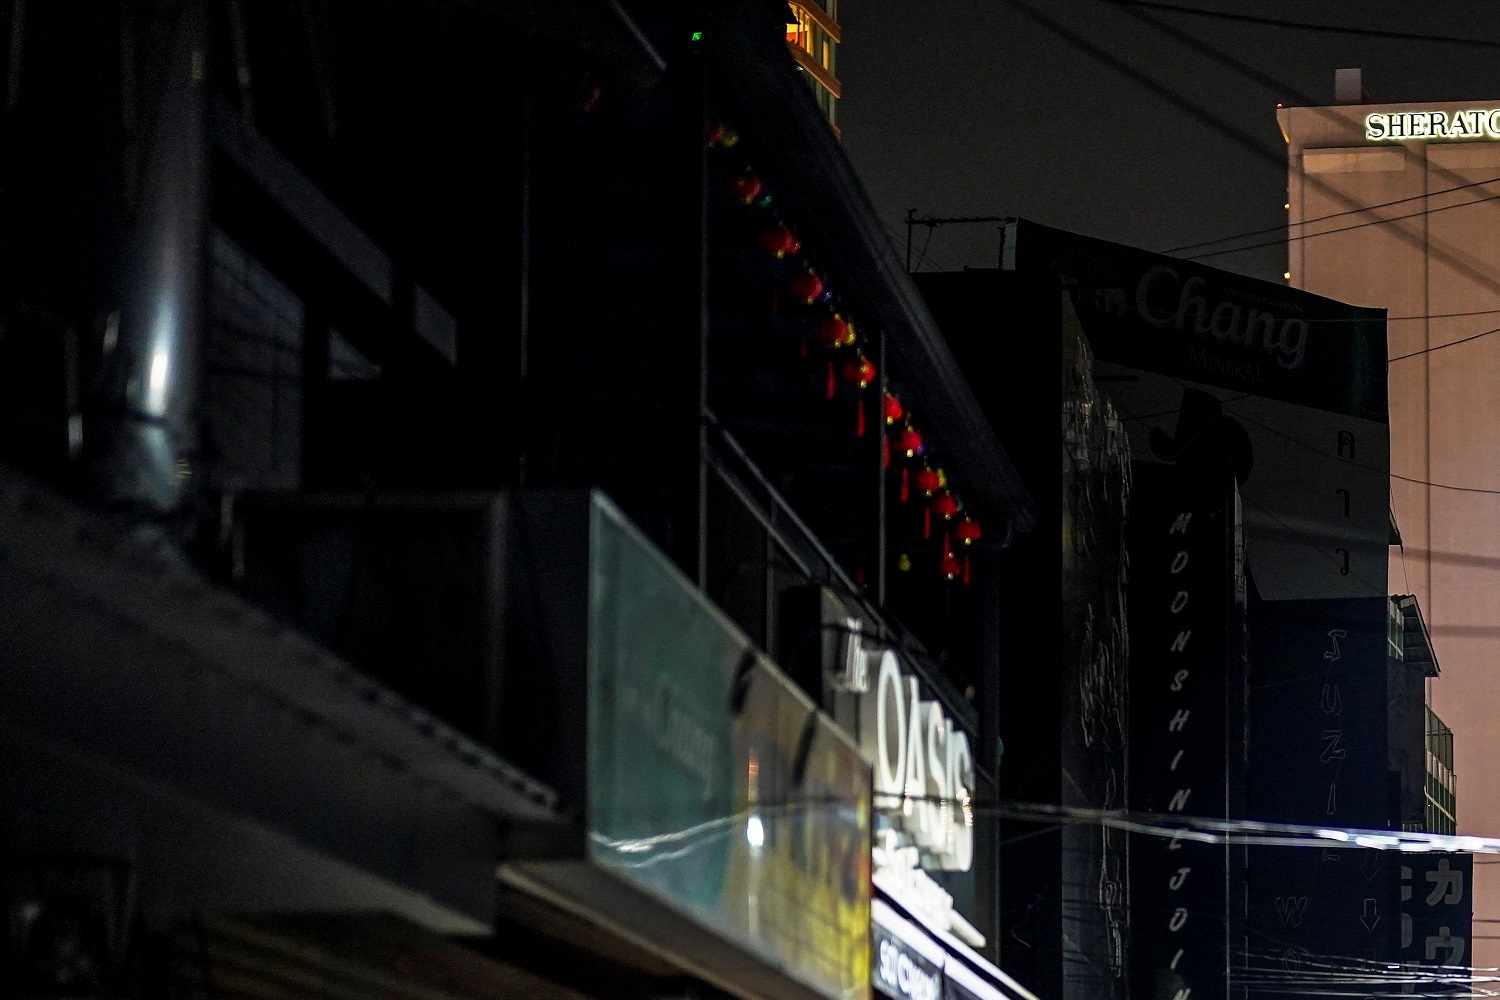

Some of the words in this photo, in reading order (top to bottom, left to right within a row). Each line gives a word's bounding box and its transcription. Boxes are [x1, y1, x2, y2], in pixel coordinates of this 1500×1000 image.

[1136, 264, 1309, 371] Chang
[877, 650, 976, 873] OASIS
[1167, 511, 1195, 851] MOONSHINE
[1320, 628, 1347, 863] SUZI
